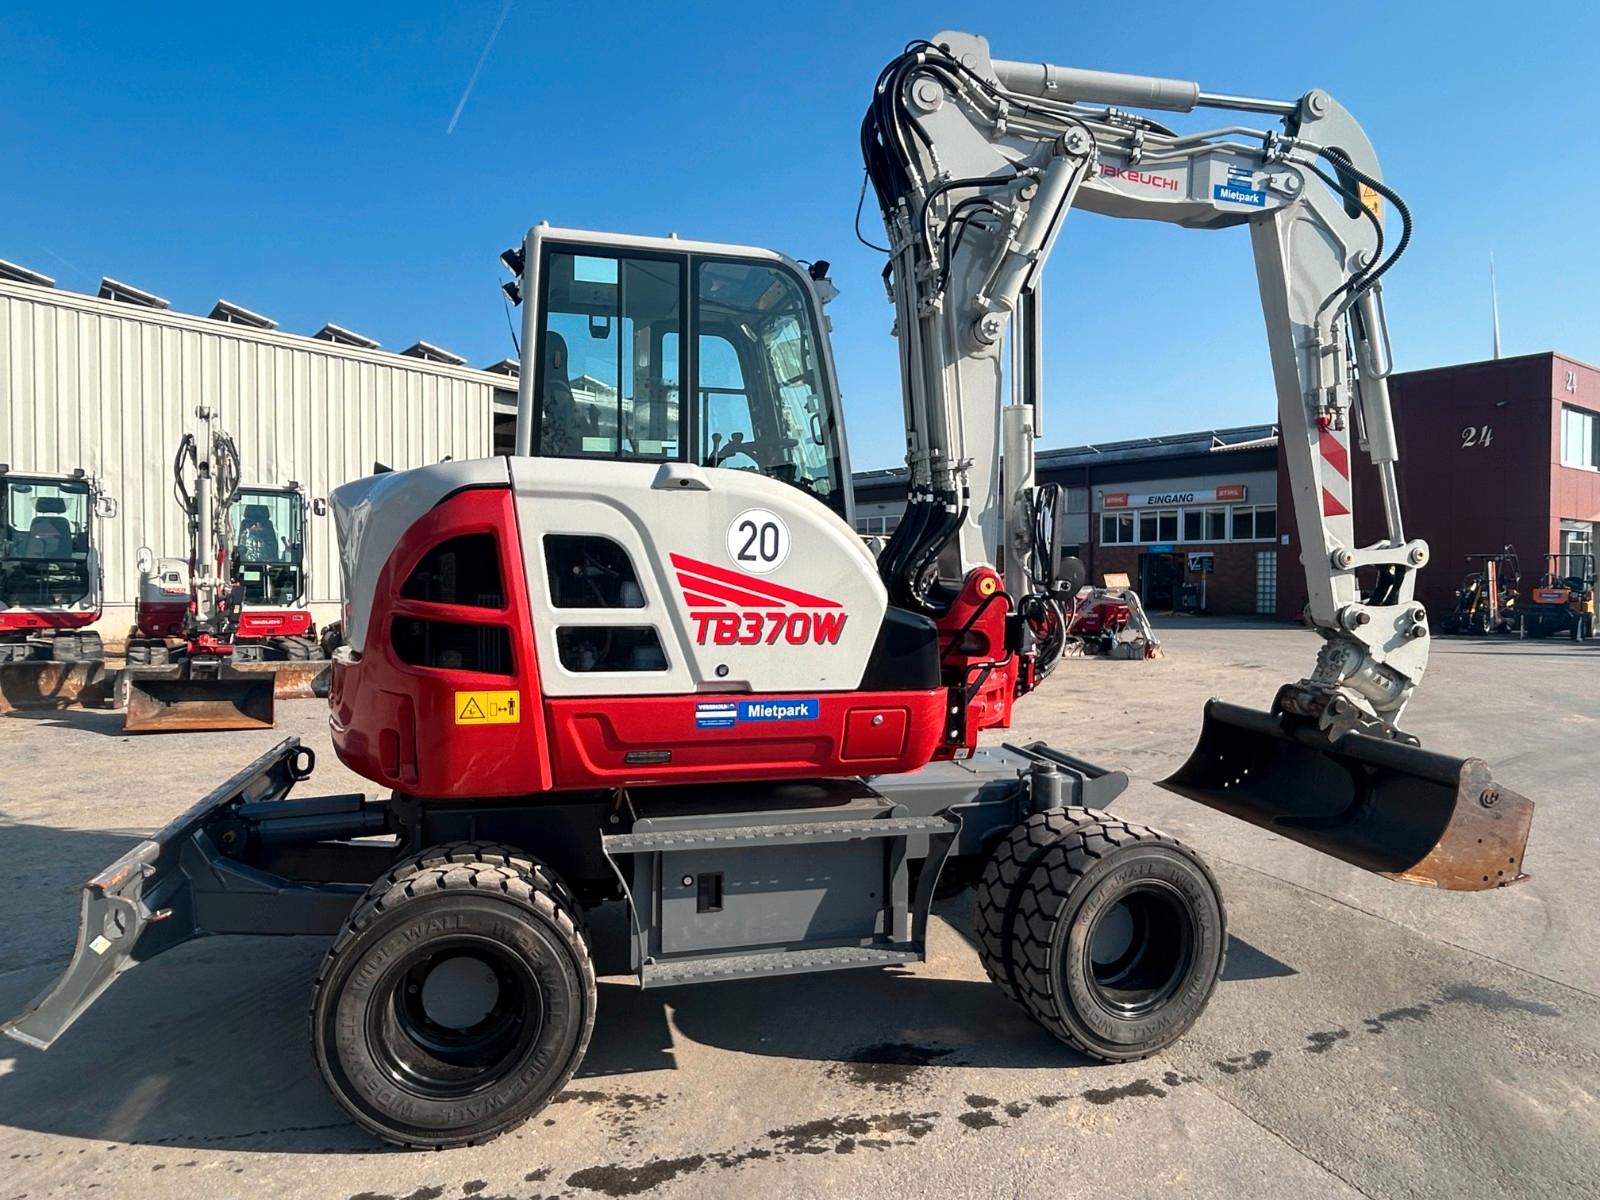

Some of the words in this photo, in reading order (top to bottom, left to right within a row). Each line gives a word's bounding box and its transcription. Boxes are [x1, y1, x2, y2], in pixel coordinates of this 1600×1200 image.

[1219, 187, 1260, 204] Mietpark
[1567, 370, 1577, 394] 24
[1462, 425, 1493, 448] 24
[1147, 493, 1194, 505] EINGANG
[737, 520, 779, 562] 20
[689, 612, 848, 645] TB370W
[748, 704, 808, 719] Mietpark
